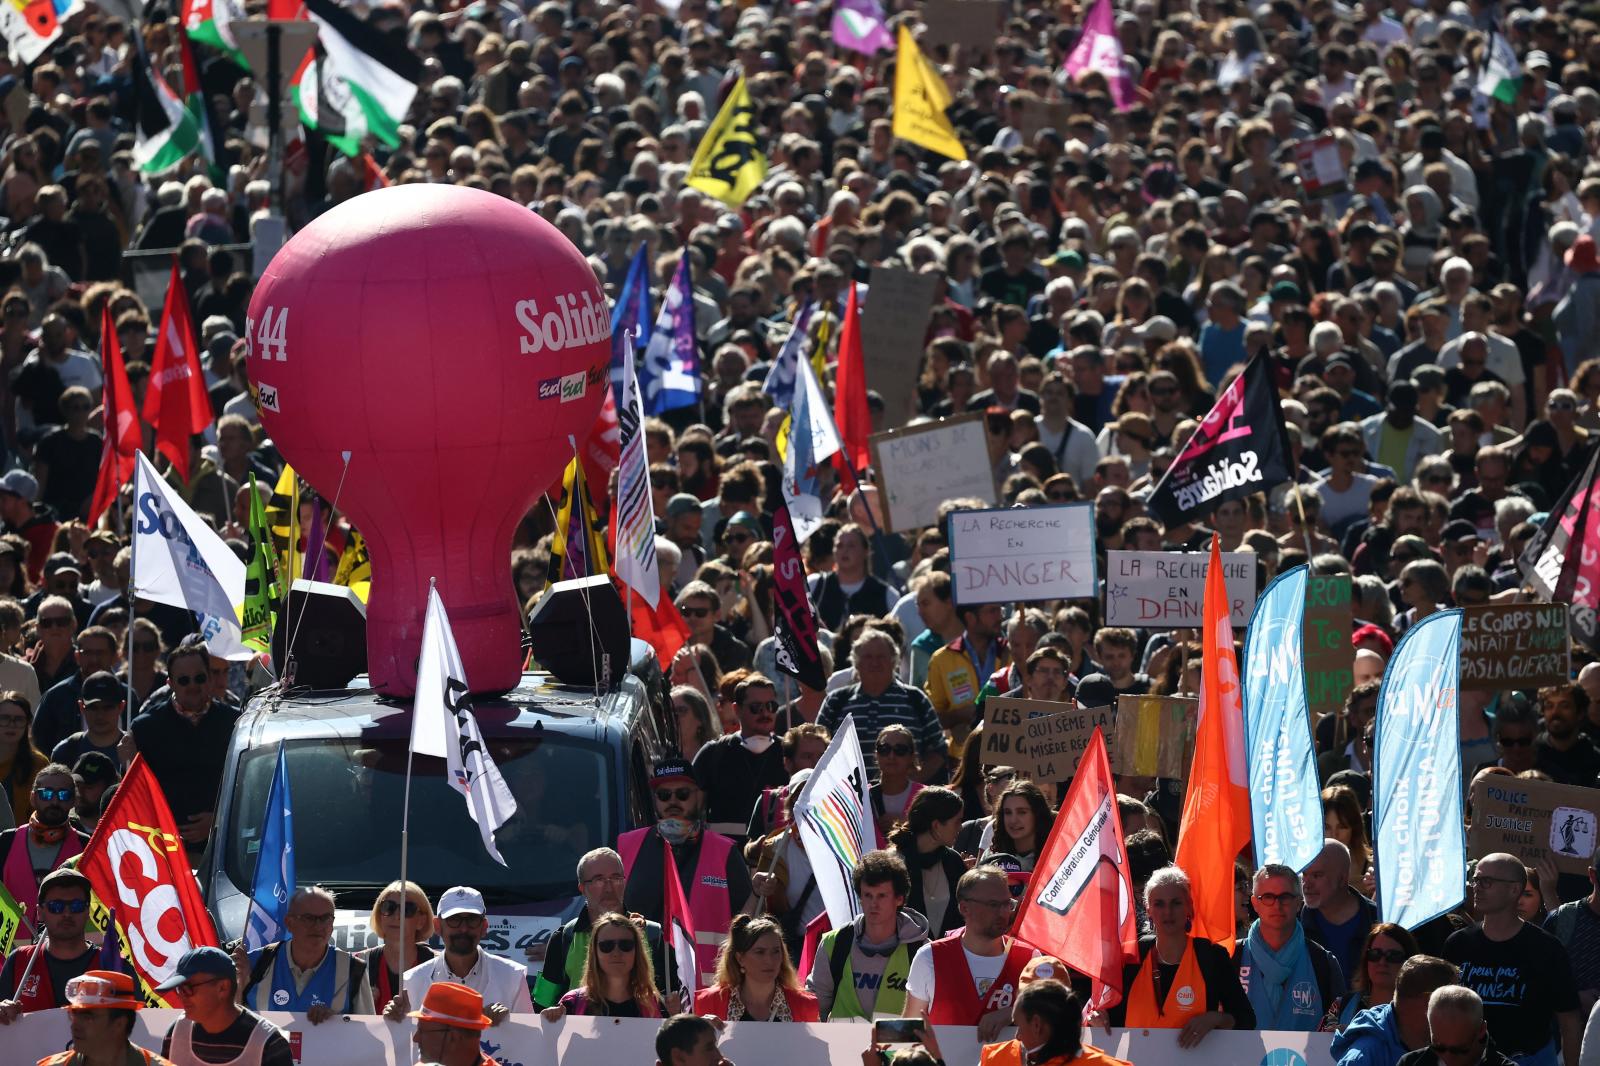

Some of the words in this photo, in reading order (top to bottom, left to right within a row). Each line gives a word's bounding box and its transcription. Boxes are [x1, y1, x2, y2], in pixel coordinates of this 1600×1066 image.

[257, 305, 288, 361] 44
[962, 519, 980, 532] LA
[962, 559, 1078, 590] DANGER
[1120, 559, 1141, 577] LA
[1156, 560, 1249, 579] RECHECHE
[1168, 586, 1189, 598] EN
[1136, 597, 1245, 620] DANR
[1480, 611, 1533, 633] CORPS
[1536, 607, 1564, 629] NU
[1508, 653, 1568, 679] GUERRE
[1305, 668, 1353, 705] UMP
[991, 708, 1021, 726] LES
[1028, 719, 1052, 738] QUI
[987, 733, 1010, 753] AU
[1037, 762, 1056, 778] LA
[1260, 738, 1274, 805] choix
[1487, 786, 1528, 803] POLICE
[1392, 776, 1410, 845] choix
[1486, 815, 1533, 832] JUSTICE
[1263, 811, 1282, 866] Mon
[1503, 833, 1535, 845] NULLE
[1044, 845, 1088, 902] Confédération
[1083, 811, 1108, 847] Générale
[1395, 853, 1413, 907] Mon
[107, 828, 193, 985] cg
